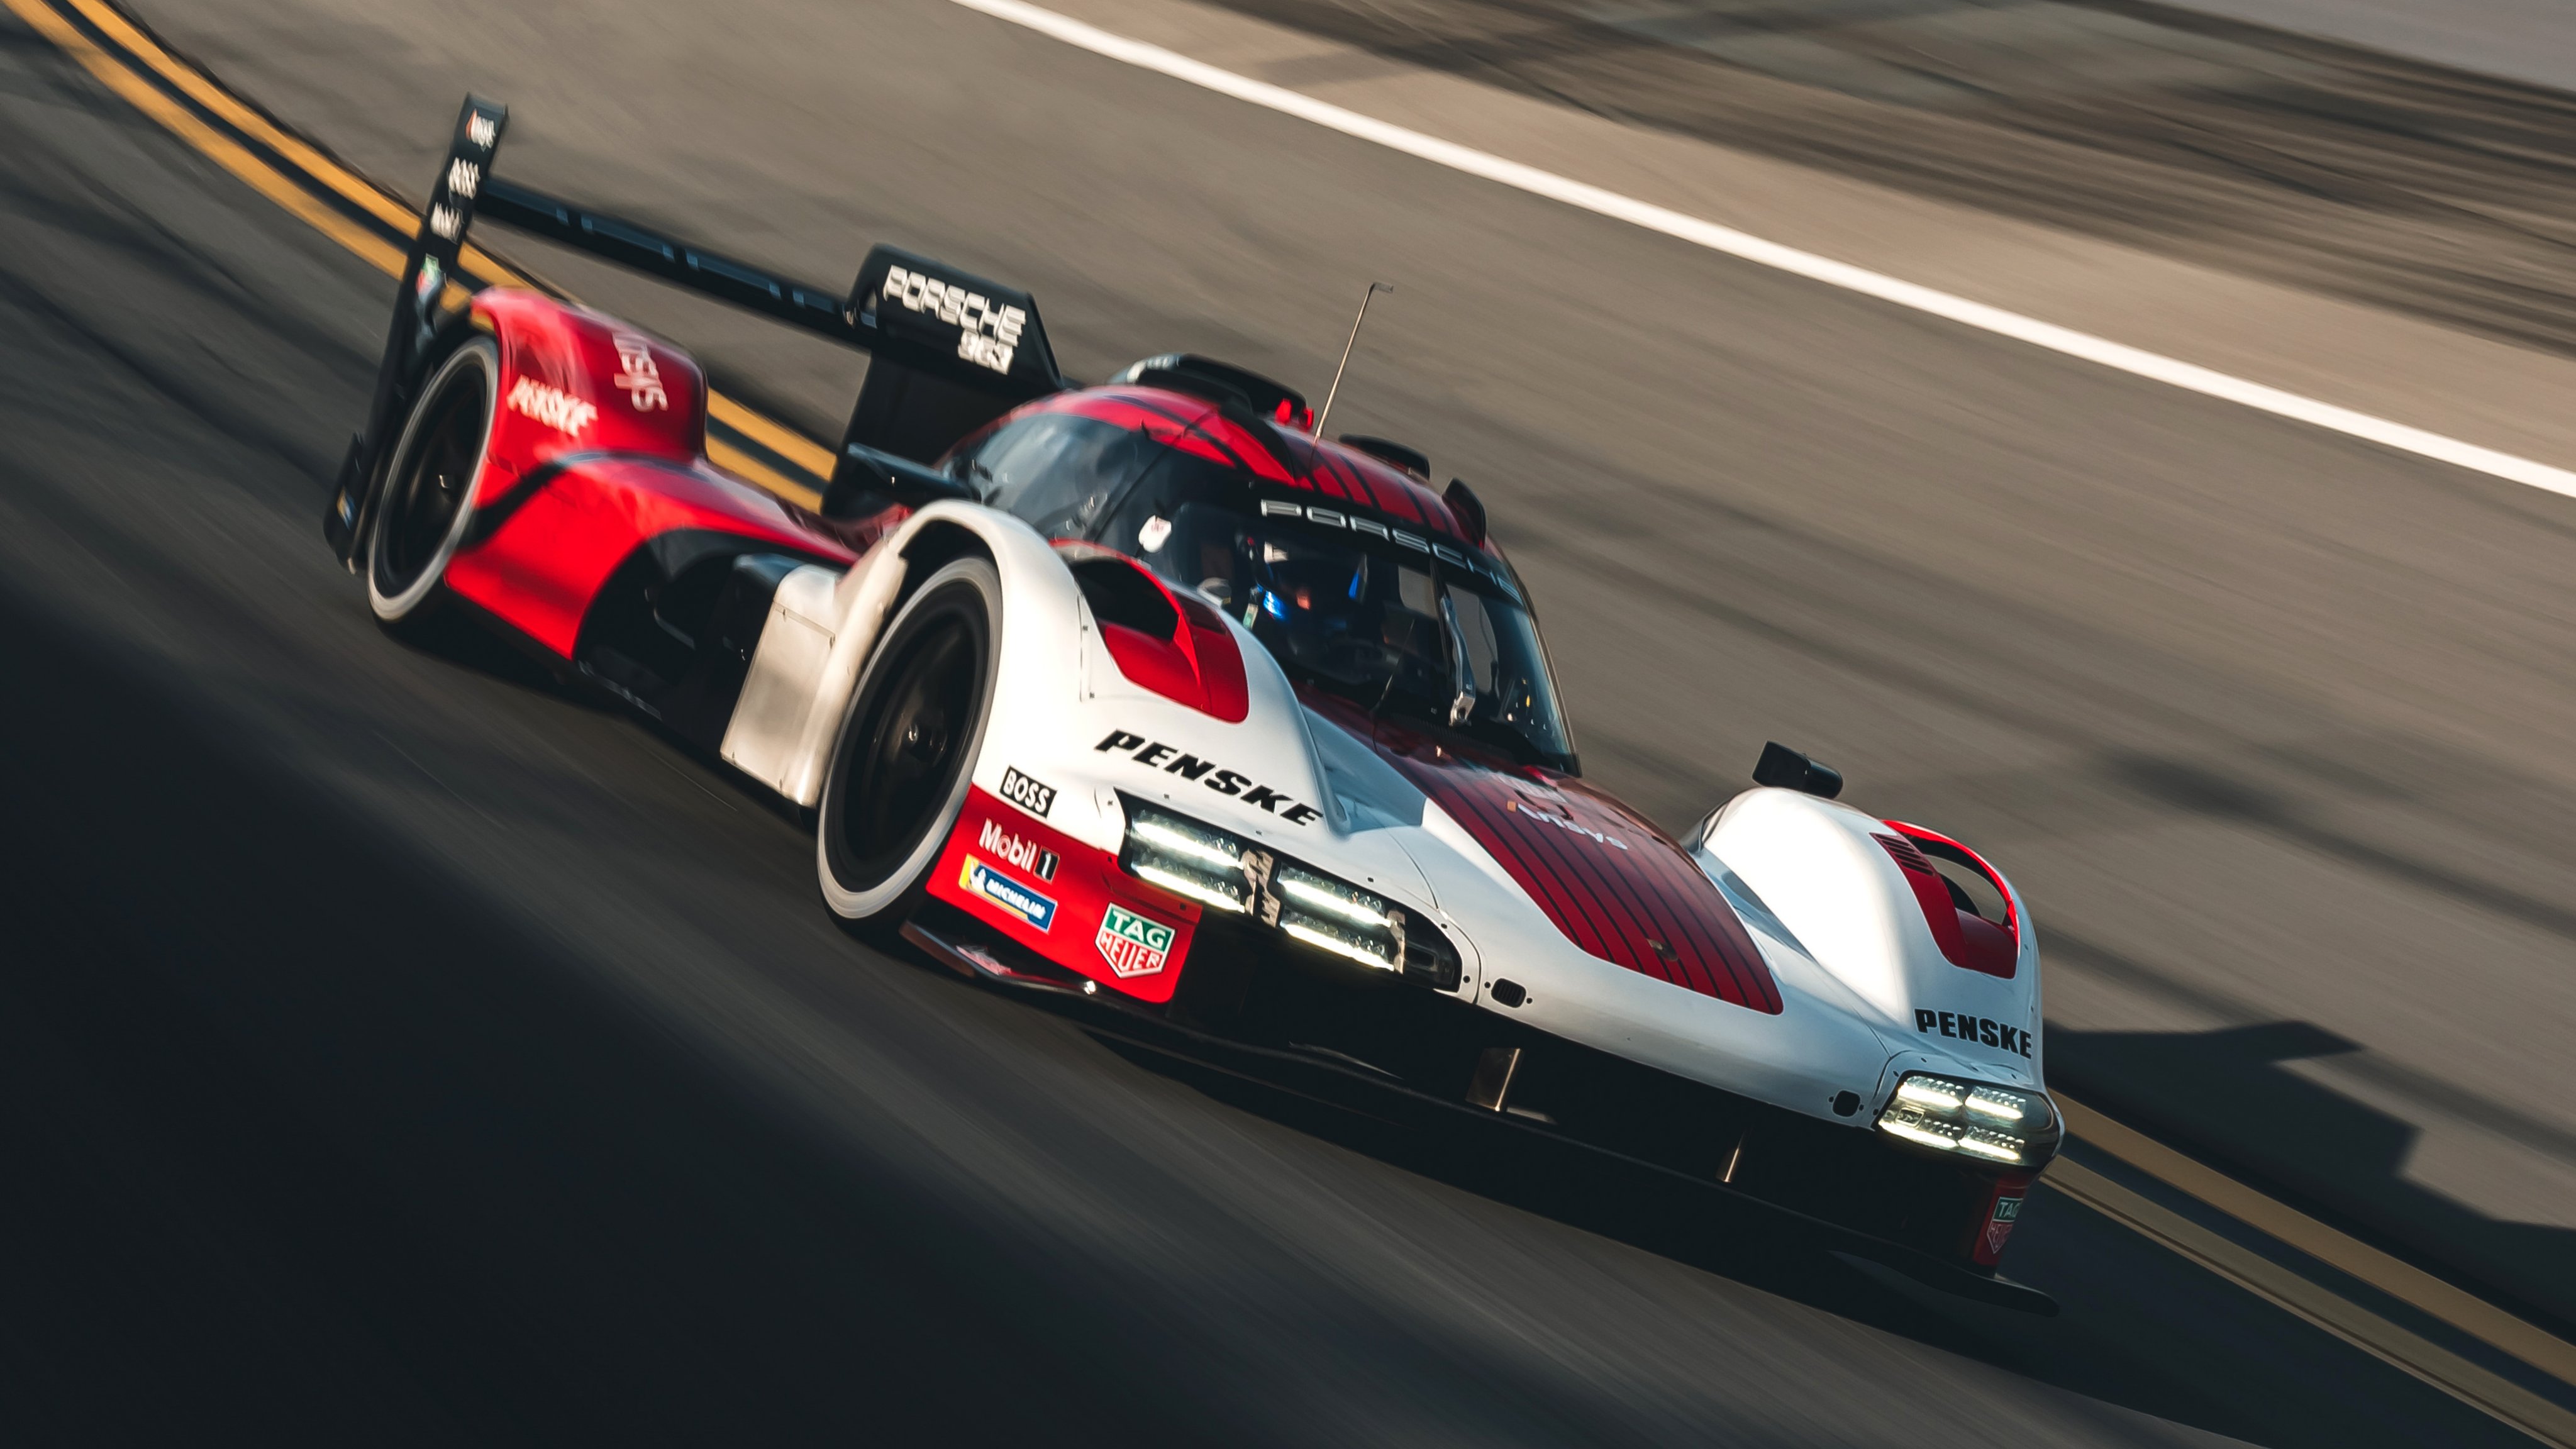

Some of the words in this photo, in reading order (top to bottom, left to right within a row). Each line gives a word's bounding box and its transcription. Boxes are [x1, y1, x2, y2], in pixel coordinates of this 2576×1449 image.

[883, 265, 1026, 347] PORSCHE
[1260, 499, 1524, 608] PORSCHE
[1002, 769, 1050, 814] BOSS
[1094, 729, 1324, 826] PENSKE
[979, 818, 1038, 873] Mobil
[986, 878, 1046, 920] MICHELIN
[1101, 932, 1160, 971] HEUER
[1112, 909, 1166, 948] TAG
[1914, 1008, 2032, 1060] PENSKE
